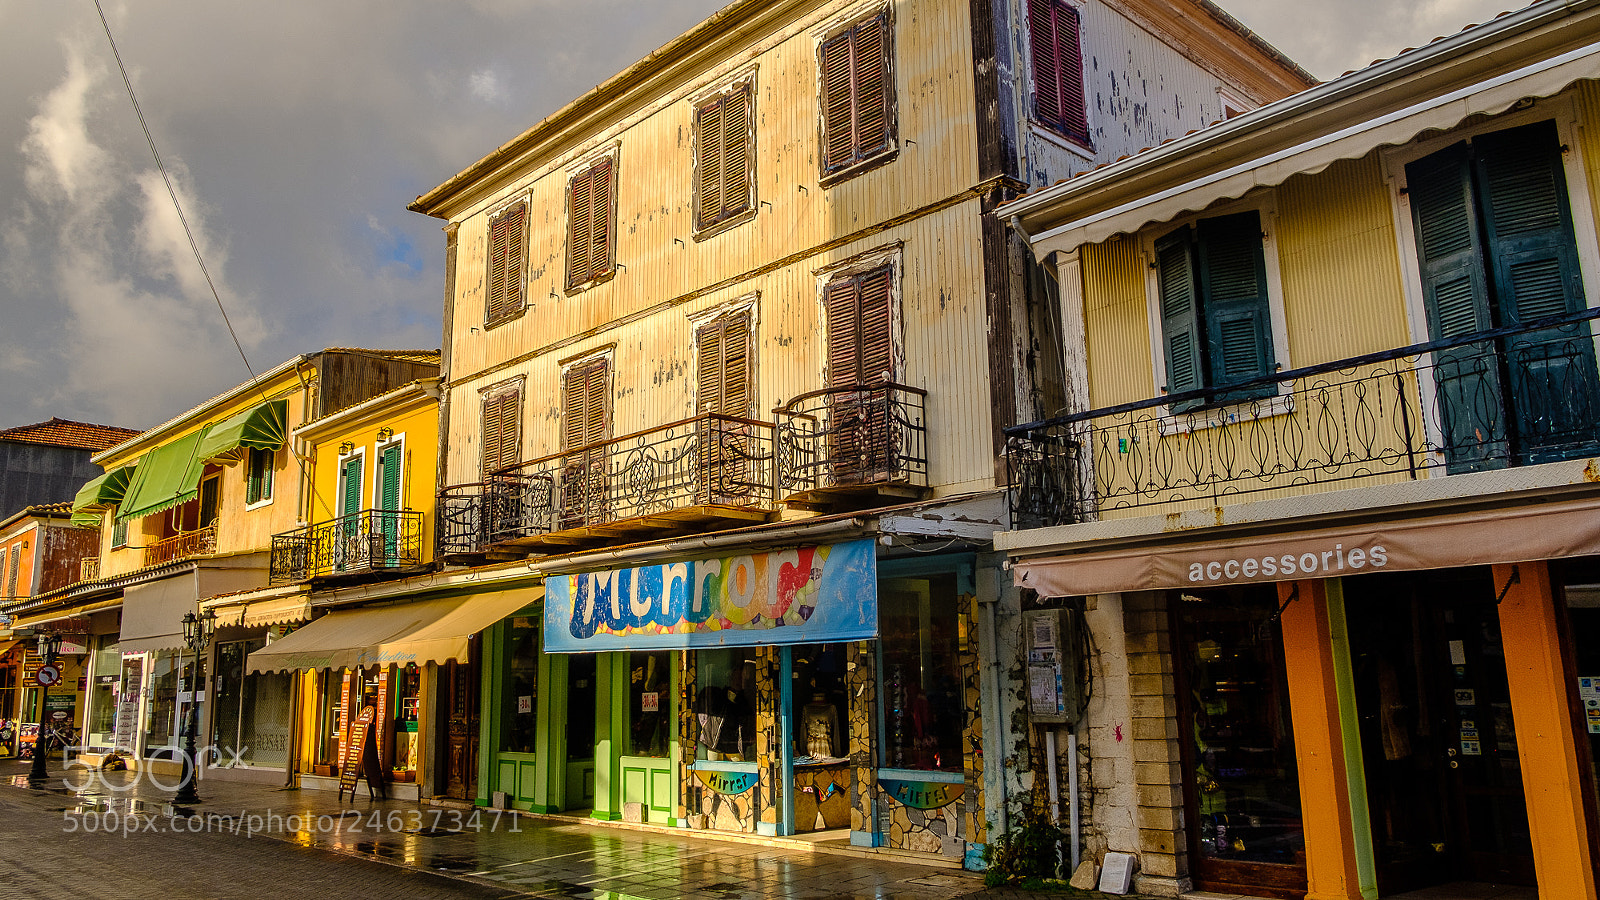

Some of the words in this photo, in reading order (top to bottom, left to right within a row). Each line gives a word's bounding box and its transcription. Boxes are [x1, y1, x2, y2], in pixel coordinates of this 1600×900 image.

[1188, 543, 1388, 583] accessories
[584, 549, 800, 625] Mirror
[356, 650, 418, 663] Collection
[708, 772, 748, 791] Mirror
[896, 784, 949, 804] Mirror
